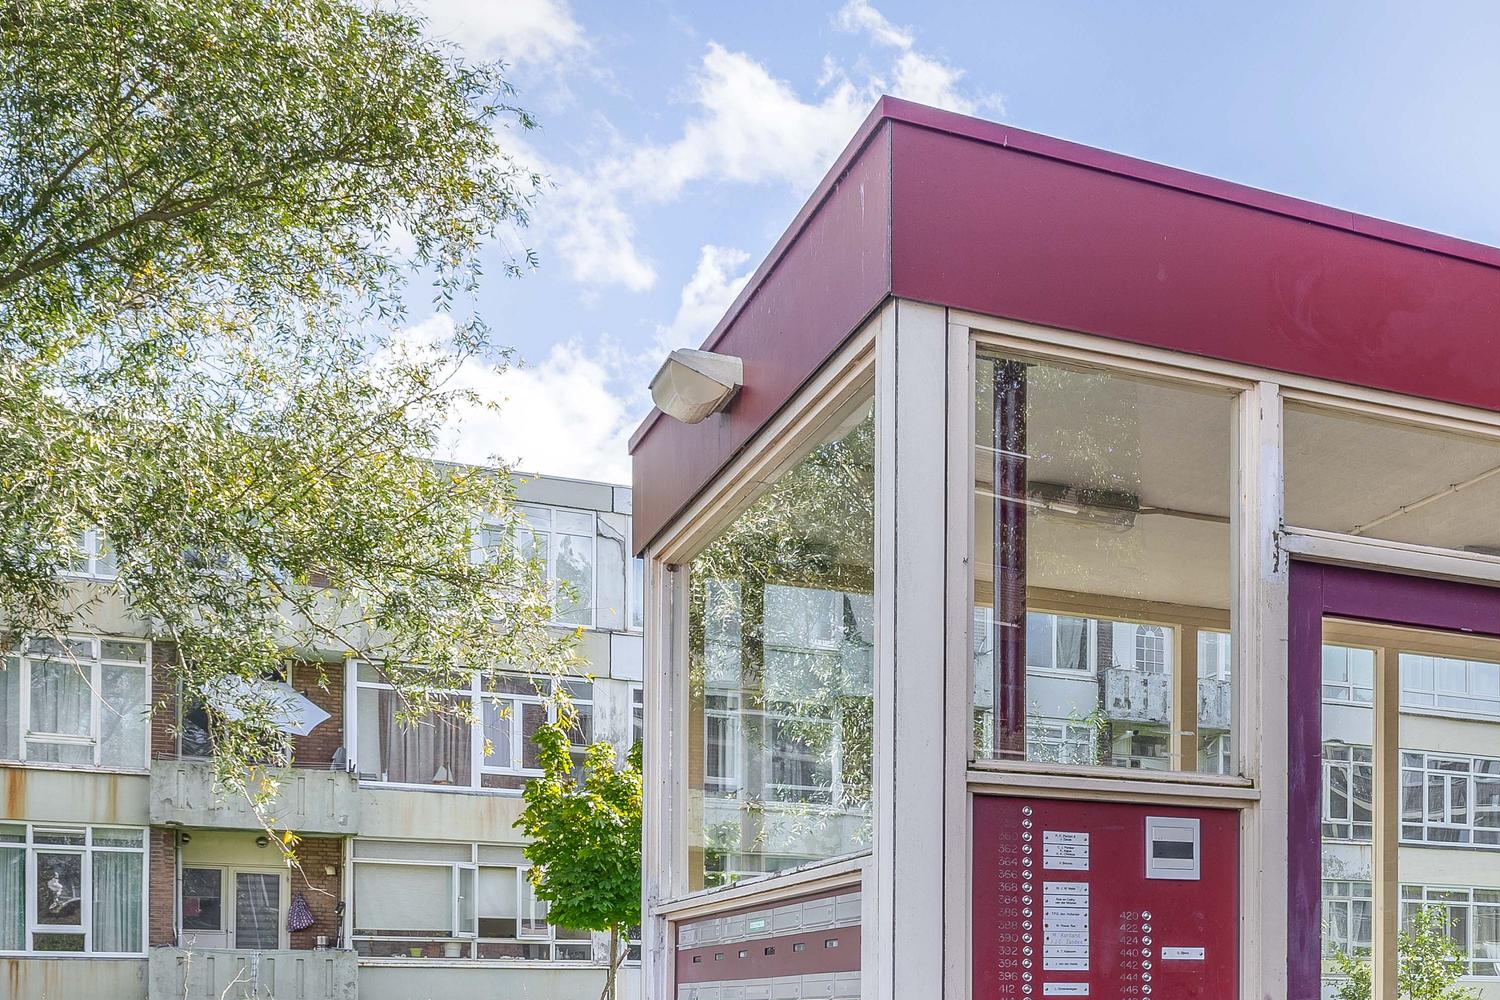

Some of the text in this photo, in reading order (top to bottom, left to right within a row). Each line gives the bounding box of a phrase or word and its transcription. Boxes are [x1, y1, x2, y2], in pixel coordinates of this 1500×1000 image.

[998, 844, 1018, 853] 362
[998, 857, 1018, 866] 364
[998, 870, 1018, 878] 366
[998, 882, 1018, 892] 368
[1120, 911, 1139, 920] 420
[1120, 924, 1139, 933] 422
[998, 933, 1018, 942] 390
[1120, 936, 1139, 945] 424
[1120, 948, 1139, 957] 440
[998, 959, 1018, 968] 394
[1120, 961, 1139, 970] 442
[998, 971, 1018, 981] 396
[1120, 973, 1139, 982] 444
[998, 985, 1015, 994] 412
[1120, 985, 1139, 994] 446
